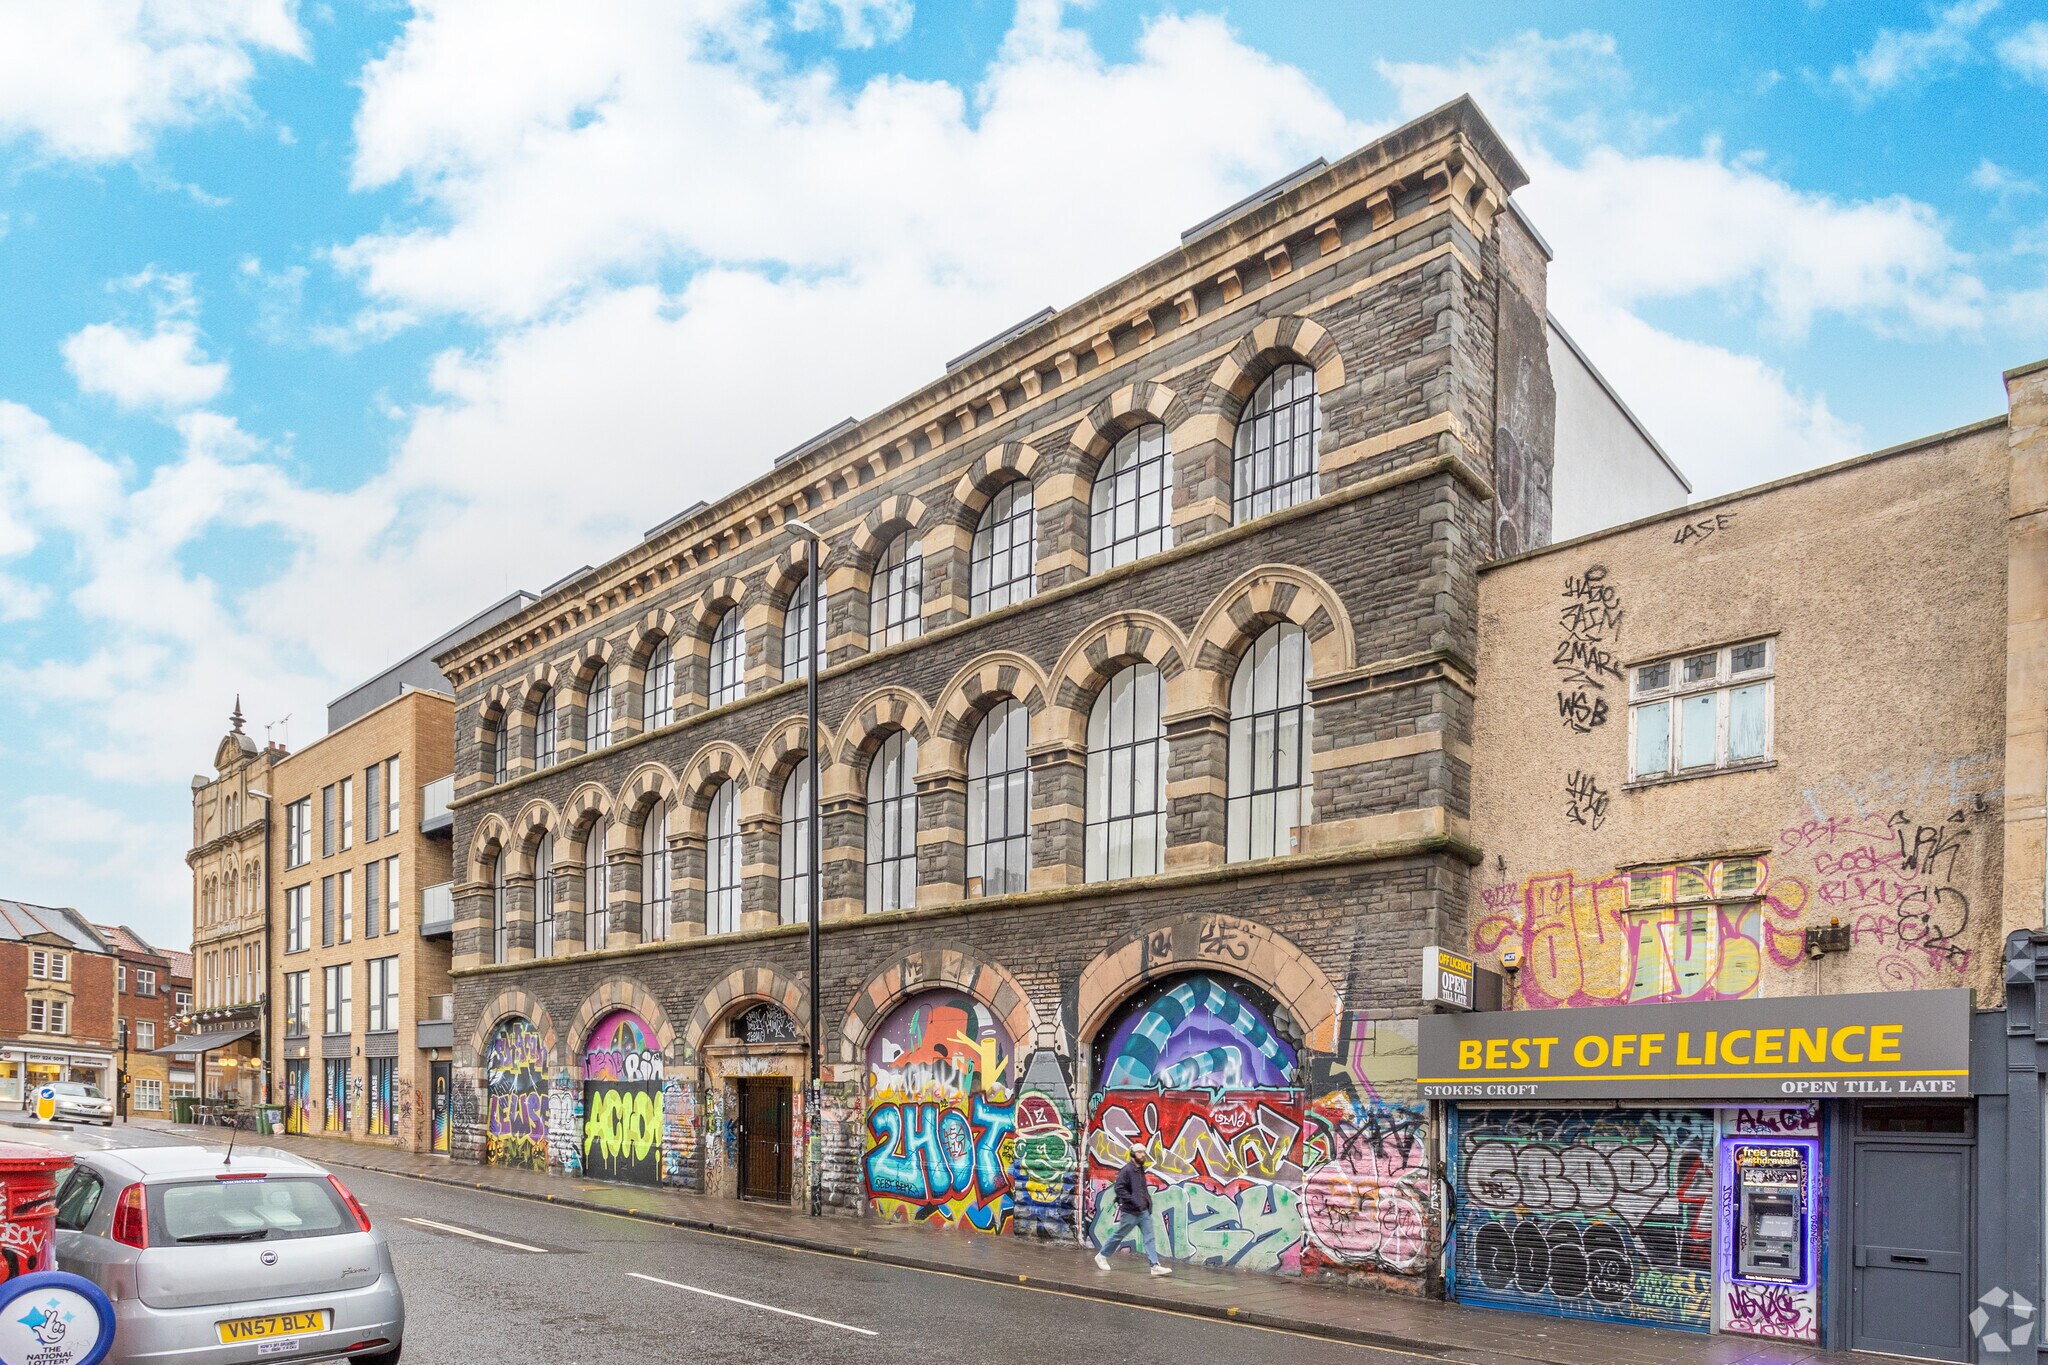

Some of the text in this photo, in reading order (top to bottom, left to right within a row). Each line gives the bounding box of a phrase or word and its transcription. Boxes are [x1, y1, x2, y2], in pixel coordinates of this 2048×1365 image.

[1439, 953, 1472, 973] OFF LICENCE
[1441, 971, 1467, 995] OPEN
[1442, 989, 1467, 1006] TILL LATE
[1457, 1024, 1904, 1071] BEST OFF LICENCE
[1424, 1084, 1538, 1097] STOKES CROFT
[1781, 1079, 1957, 1095] OPEN TILL LATE
[1743, 1146, 1799, 1158] free cash
[1743, 1157, 1798, 1165] withdrawals
[228, 1313, 317, 1338] VN57 BLX
[26, 1350, 74, 1361] NATIONAL
[28, 1357, 71, 1365] LOTTERY
